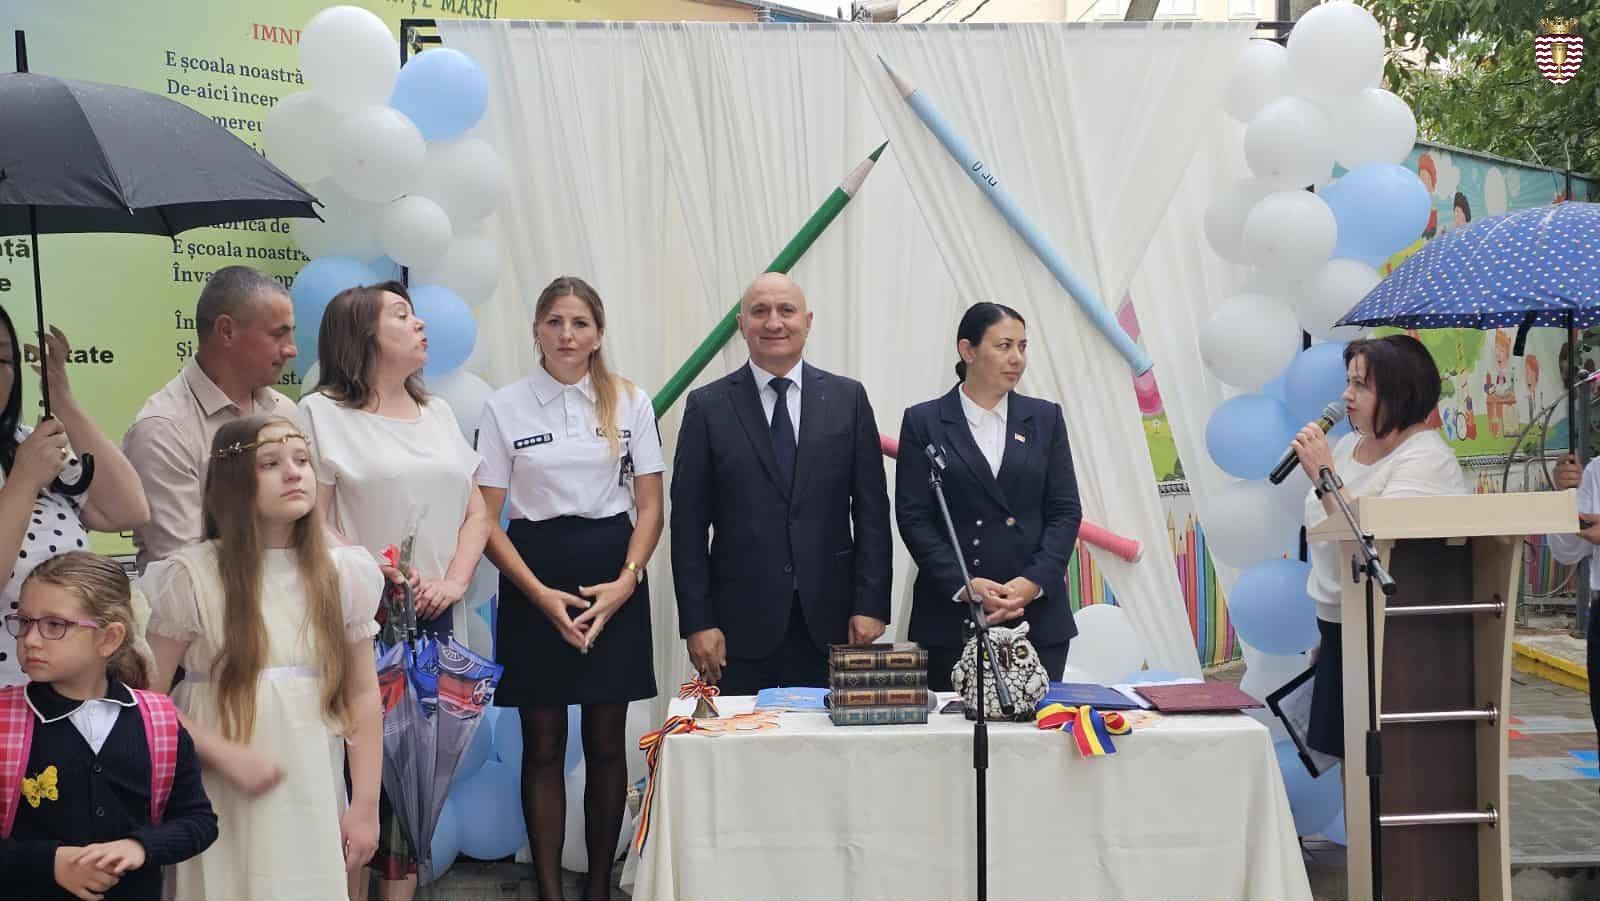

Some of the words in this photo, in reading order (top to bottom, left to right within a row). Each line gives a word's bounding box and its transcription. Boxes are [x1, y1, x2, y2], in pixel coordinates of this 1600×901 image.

[165, 50, 177, 67] E
[180, 56, 236, 75] școala
[240, 63, 305, 85] noastră
[167, 78, 229, 101] De-aici
[270, 217, 290, 233] de
[173, 239, 184, 254] E
[187, 241, 242, 260] școala
[176, 340, 193, 362] Și
